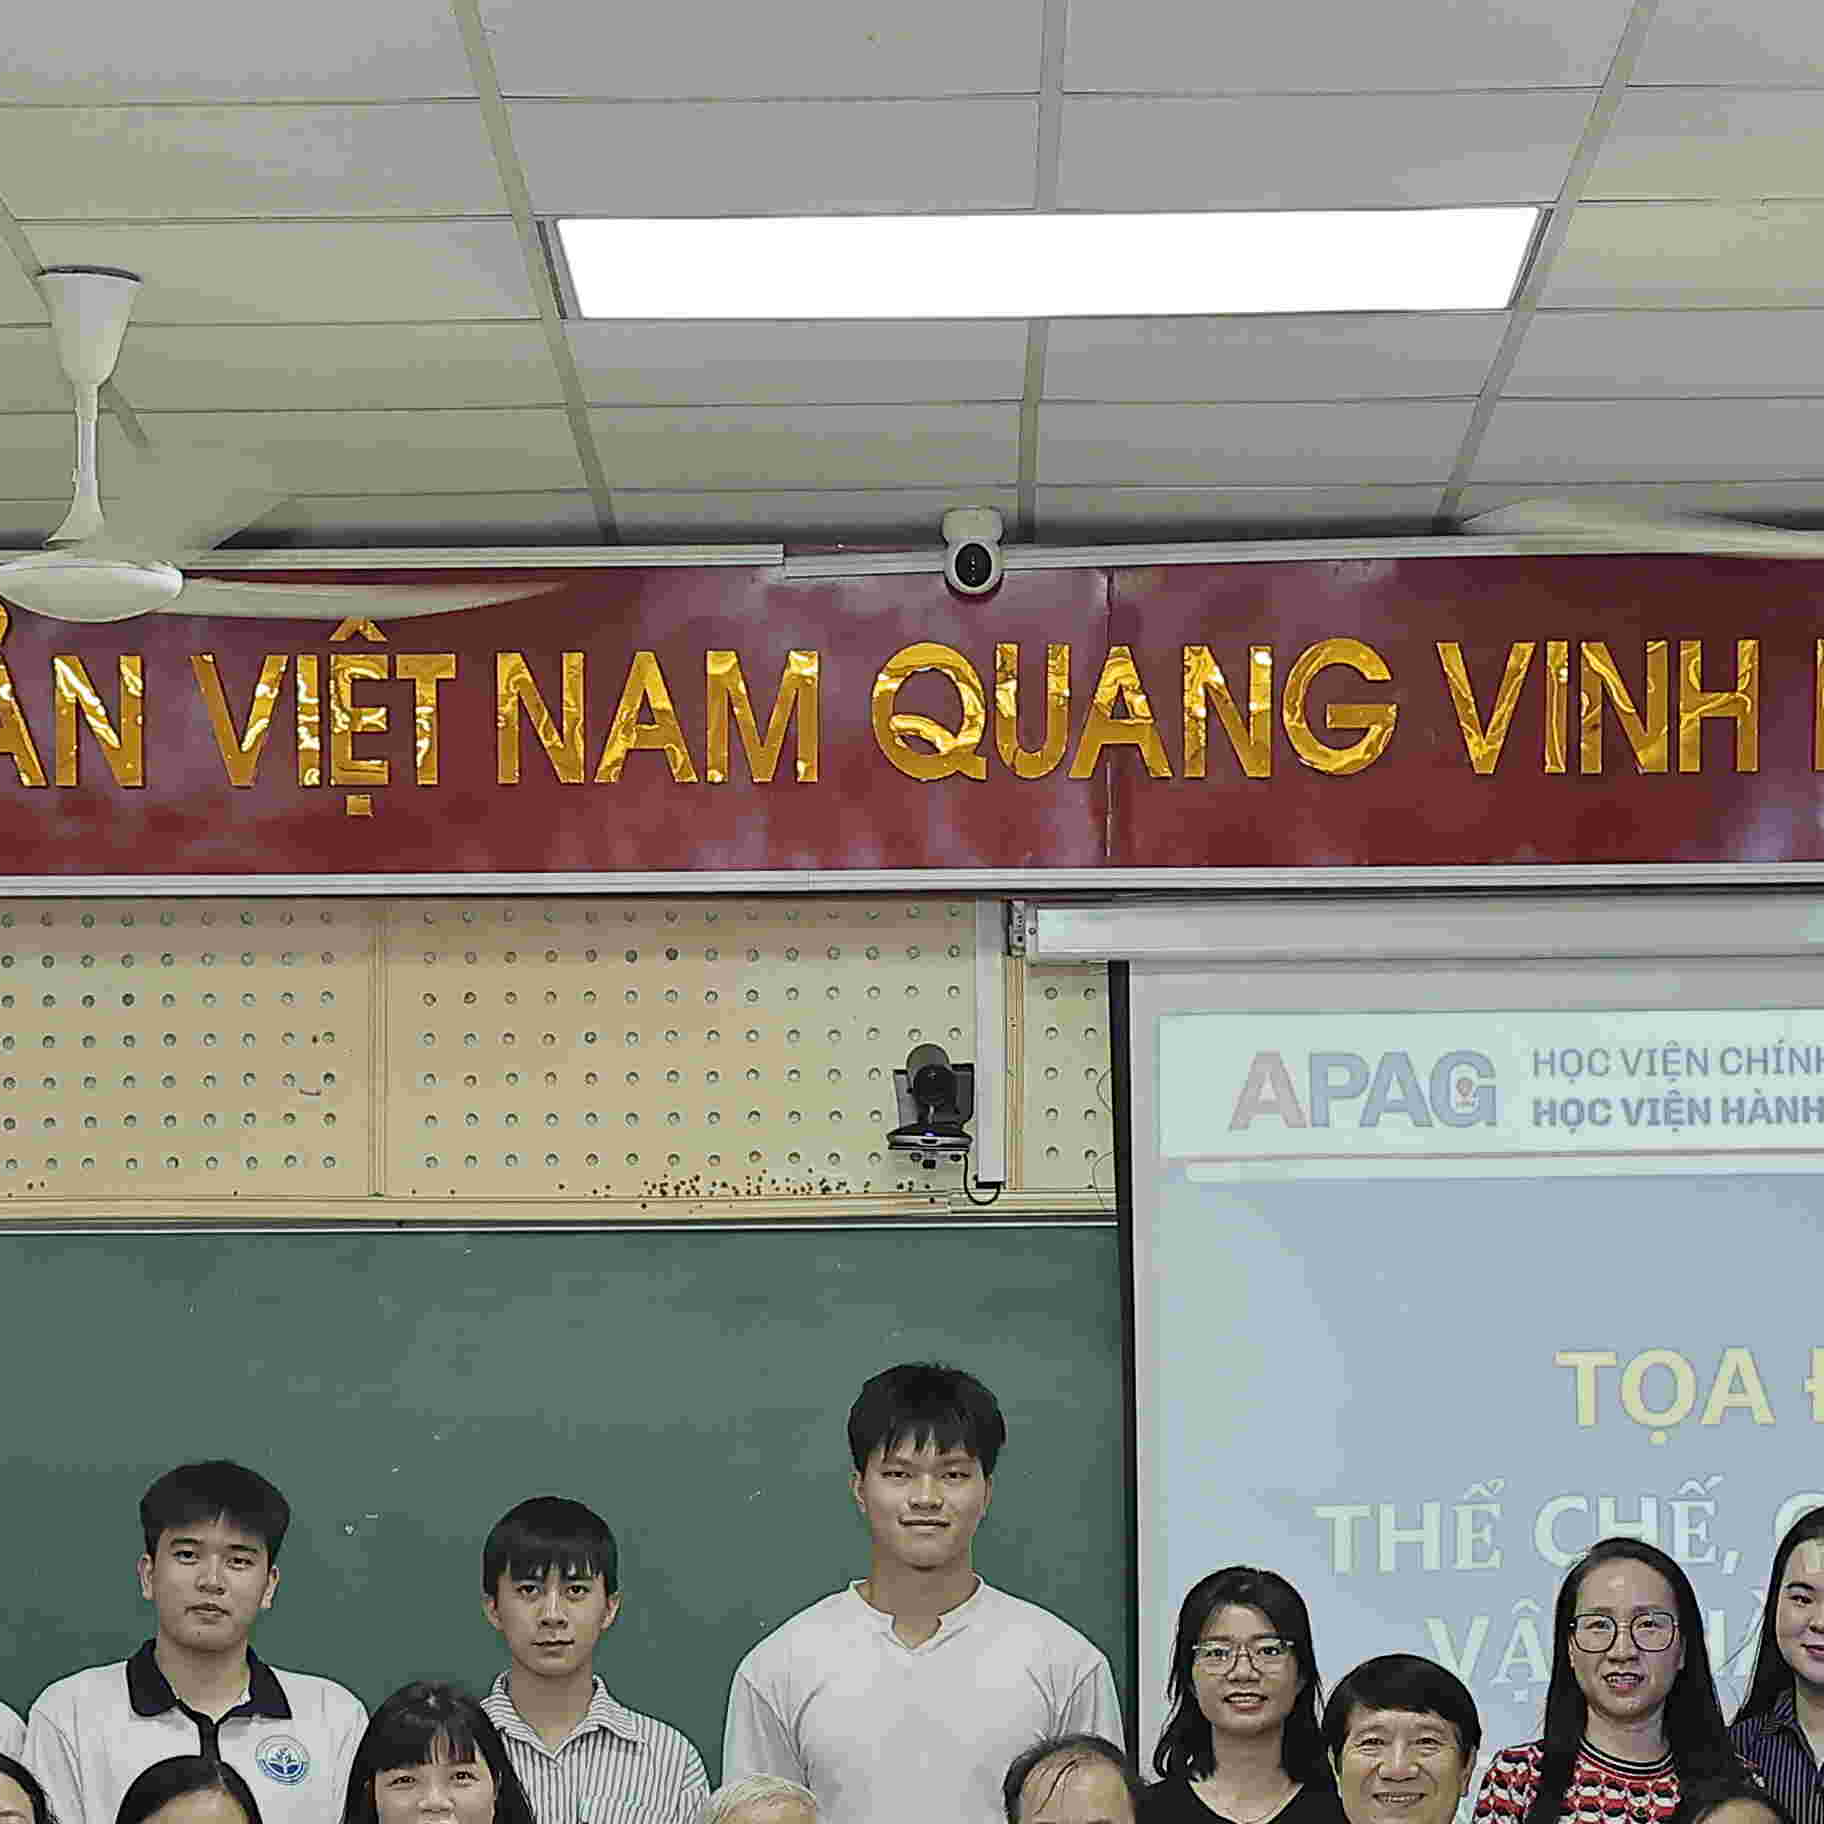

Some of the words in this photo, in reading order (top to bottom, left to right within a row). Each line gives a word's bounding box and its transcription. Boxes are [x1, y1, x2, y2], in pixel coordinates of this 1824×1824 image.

[190, 619, 458, 816] VIỆT
[494, 650, 819, 785] NAM
[871, 636, 1398, 783] QUANG
[1437, 639, 1759, 777] VINH
[1228, 1050, 1497, 1131] APAG
[1533, 1047, 1610, 1084] HỌC
[1622, 1040, 1708, 1083] VIỆN
[1533, 1096, 1612, 1134] HỌC
[1621, 1090, 1711, 1134] VIỆN
[1722, 1087, 1824, 1126] HÀNH
[1554, 1345, 1776, 1444] TỌA
[1313, 1478, 1505, 1575] THỂ
[1424, 1598, 1550, 1702] VẬ
